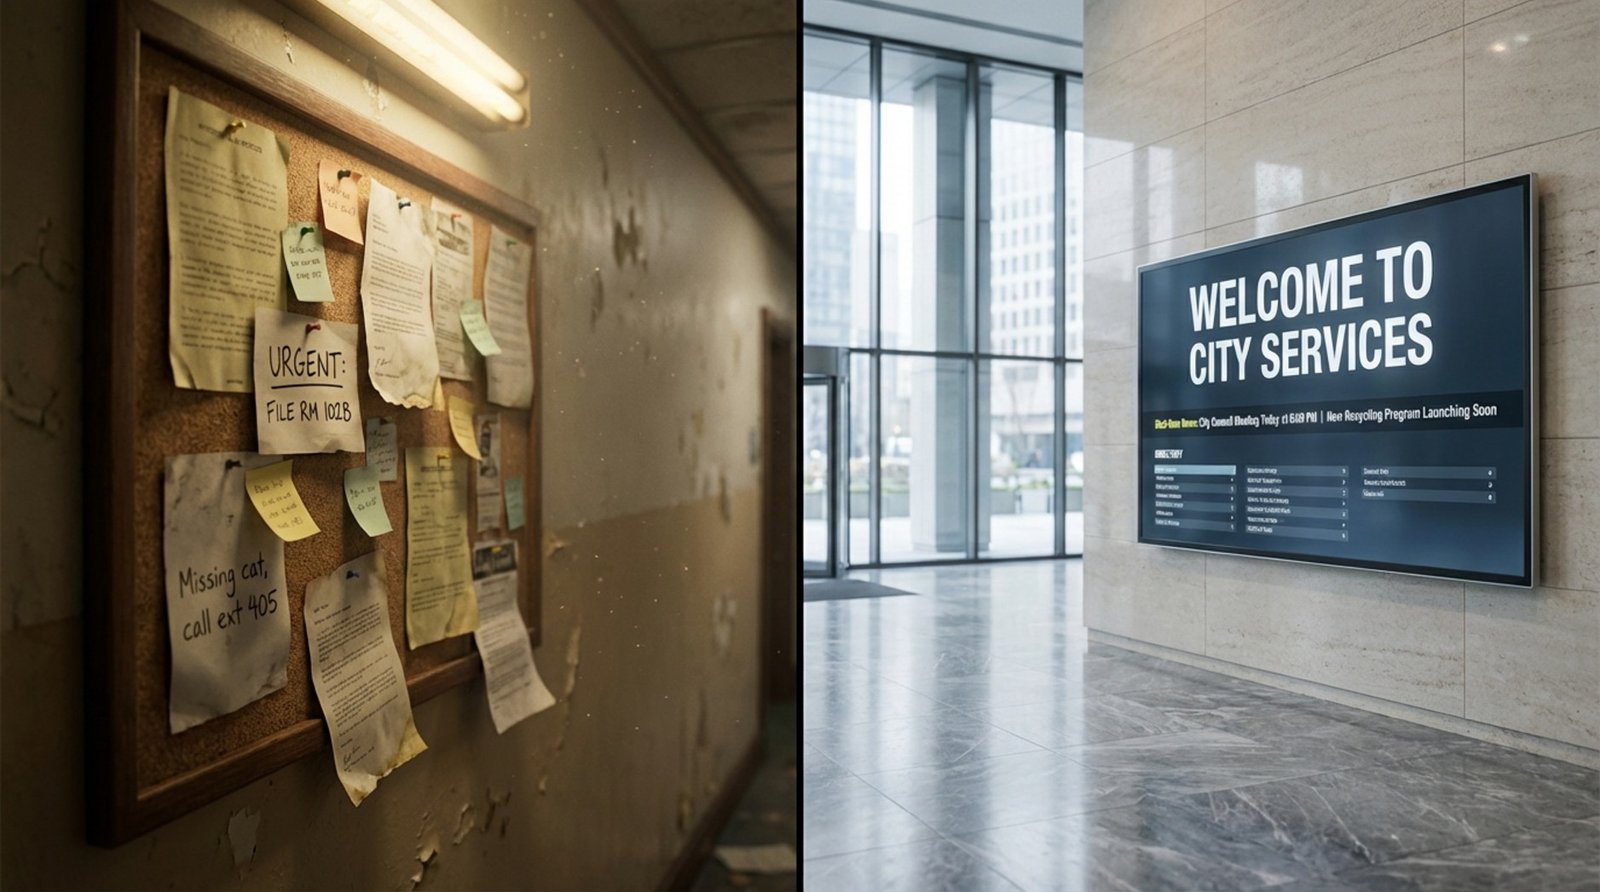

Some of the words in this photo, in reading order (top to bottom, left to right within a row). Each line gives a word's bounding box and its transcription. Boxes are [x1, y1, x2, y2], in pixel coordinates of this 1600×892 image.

[1189, 253, 1364, 332] WELCOME
[1376, 240, 1433, 303] TO
[269, 345, 346, 379] URGENT:
[1189, 336, 1252, 385] CITY
[1260, 312, 1434, 380] SERVICES
[266, 399, 295, 423] FILE
[299, 400, 319, 421] RM
[324, 401, 352, 422] 102B
[1422, 404, 1470, 420] Launching
[1472, 402, 1498, 417] Soon
[178, 566, 236, 598] Missing
[241, 551, 268, 580] cat,
[183, 607, 212, 641] call
[217, 599, 243, 629] ext
[248, 589, 278, 620] 405
